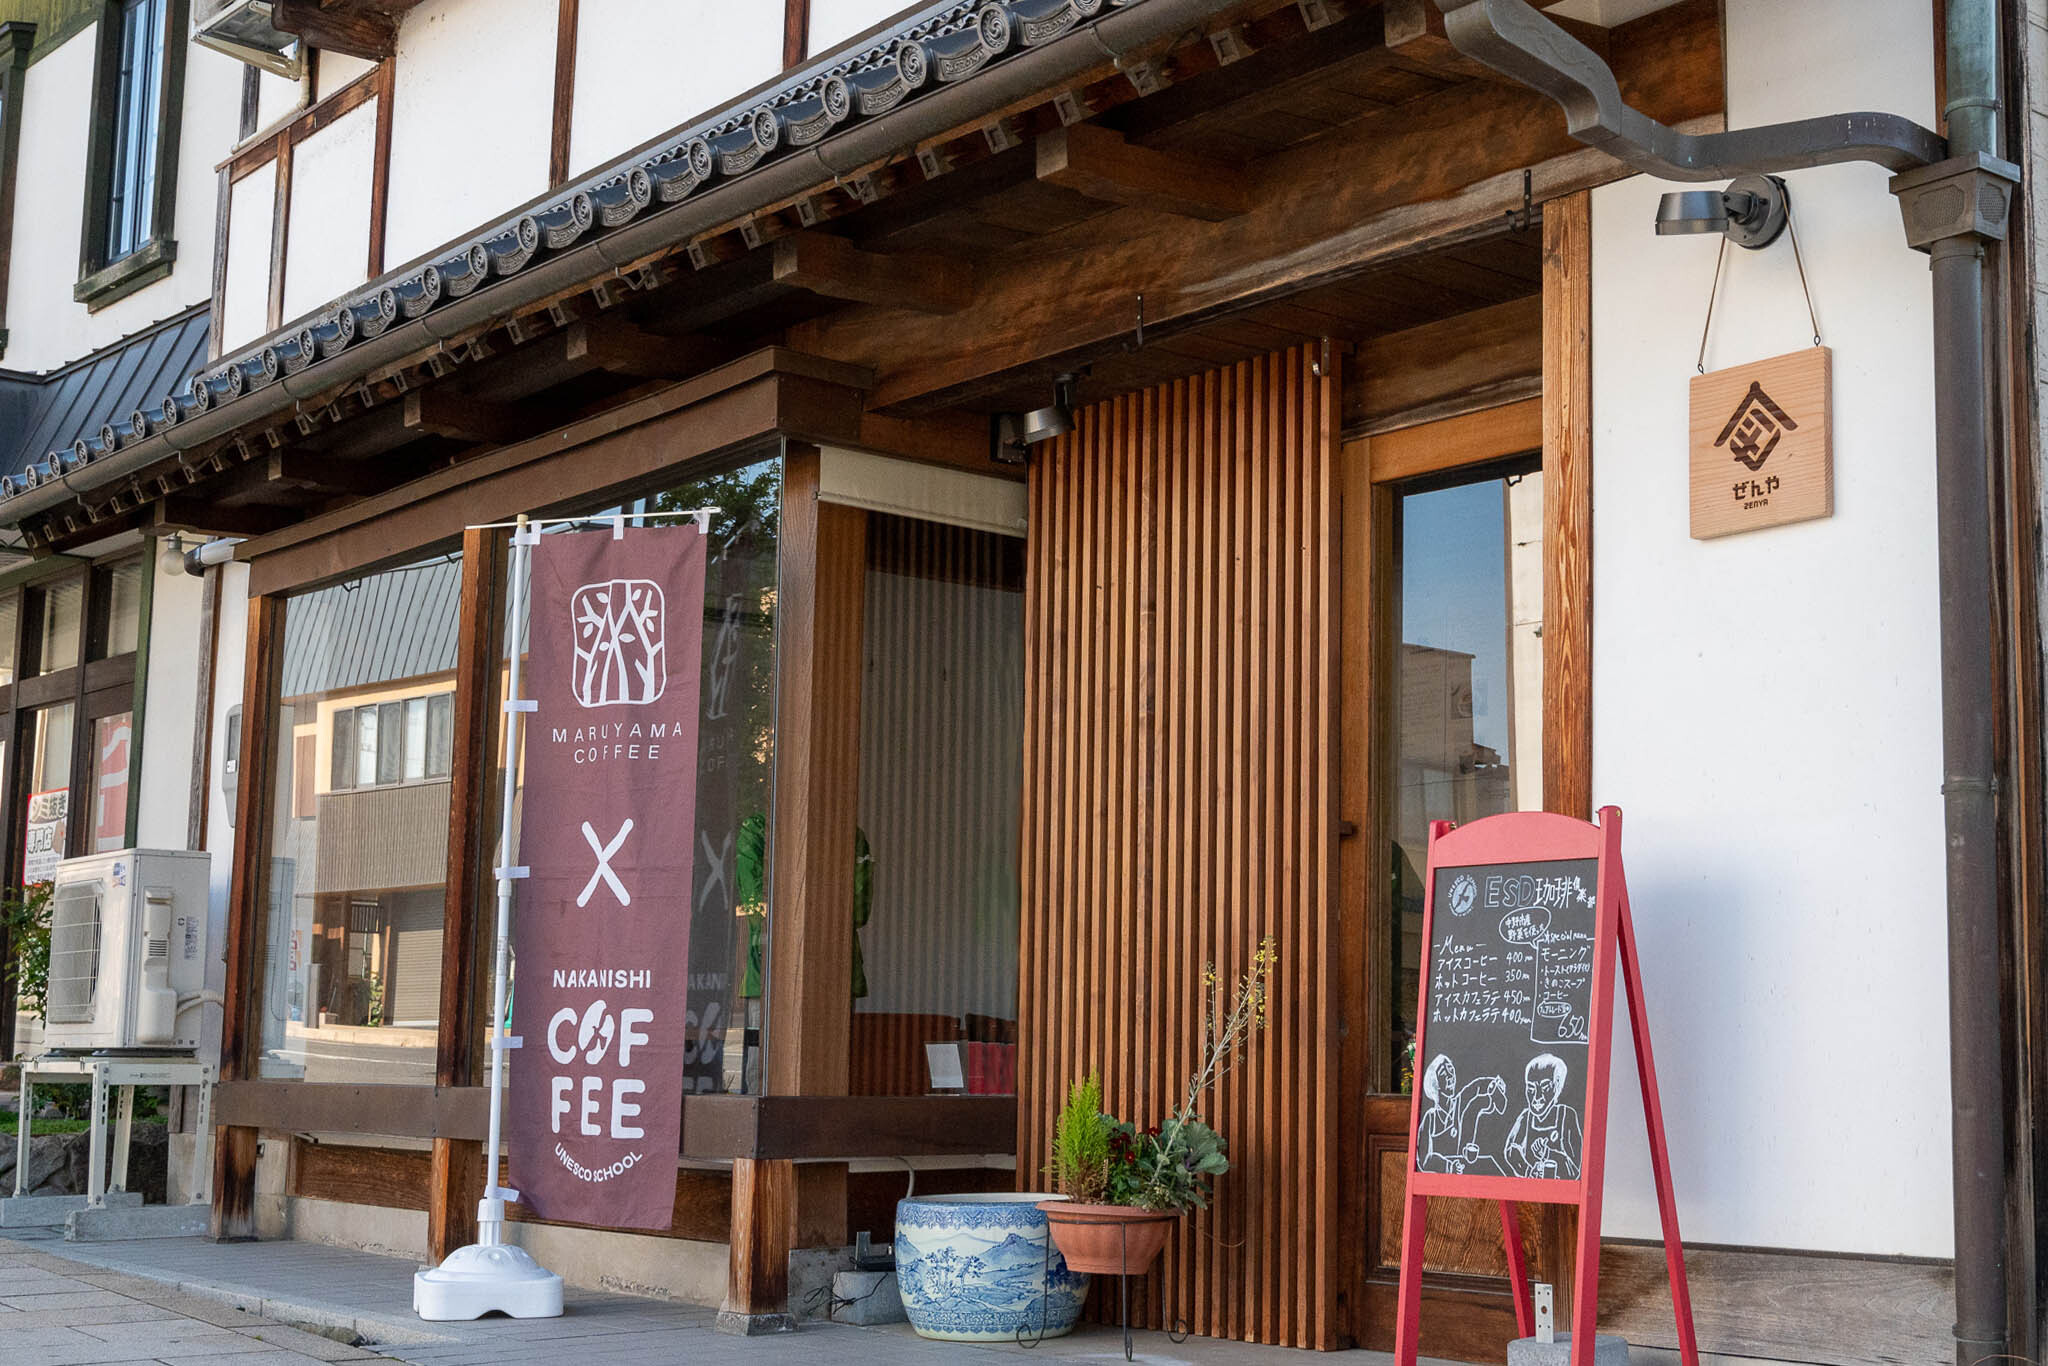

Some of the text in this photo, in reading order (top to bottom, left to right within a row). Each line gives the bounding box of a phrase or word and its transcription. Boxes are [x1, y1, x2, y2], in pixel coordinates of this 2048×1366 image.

[1732, 475, 1780, 501] ぜんや
[552, 721, 683, 743] MARUYAMA
[573, 744, 661, 764] COFFEE
[1440, 934, 1474, 955] Menu
[1541, 945, 1591, 962] モーニング
[1438, 955, 1498, 971] アイスコーヒー
[553, 969, 651, 989] NAKANISHI
[1435, 971, 1497, 990] ホットコーヒー
[1544, 977, 1586, 989] きのこスープ
[1435, 990, 1501, 1007] アイスカフェラテ
[1543, 991, 1569, 1000] コーヒー
[1433, 1007, 1500, 1023] ホットカフェラテ
[554, 1142, 643, 1183] UNESCO SCHOOL
